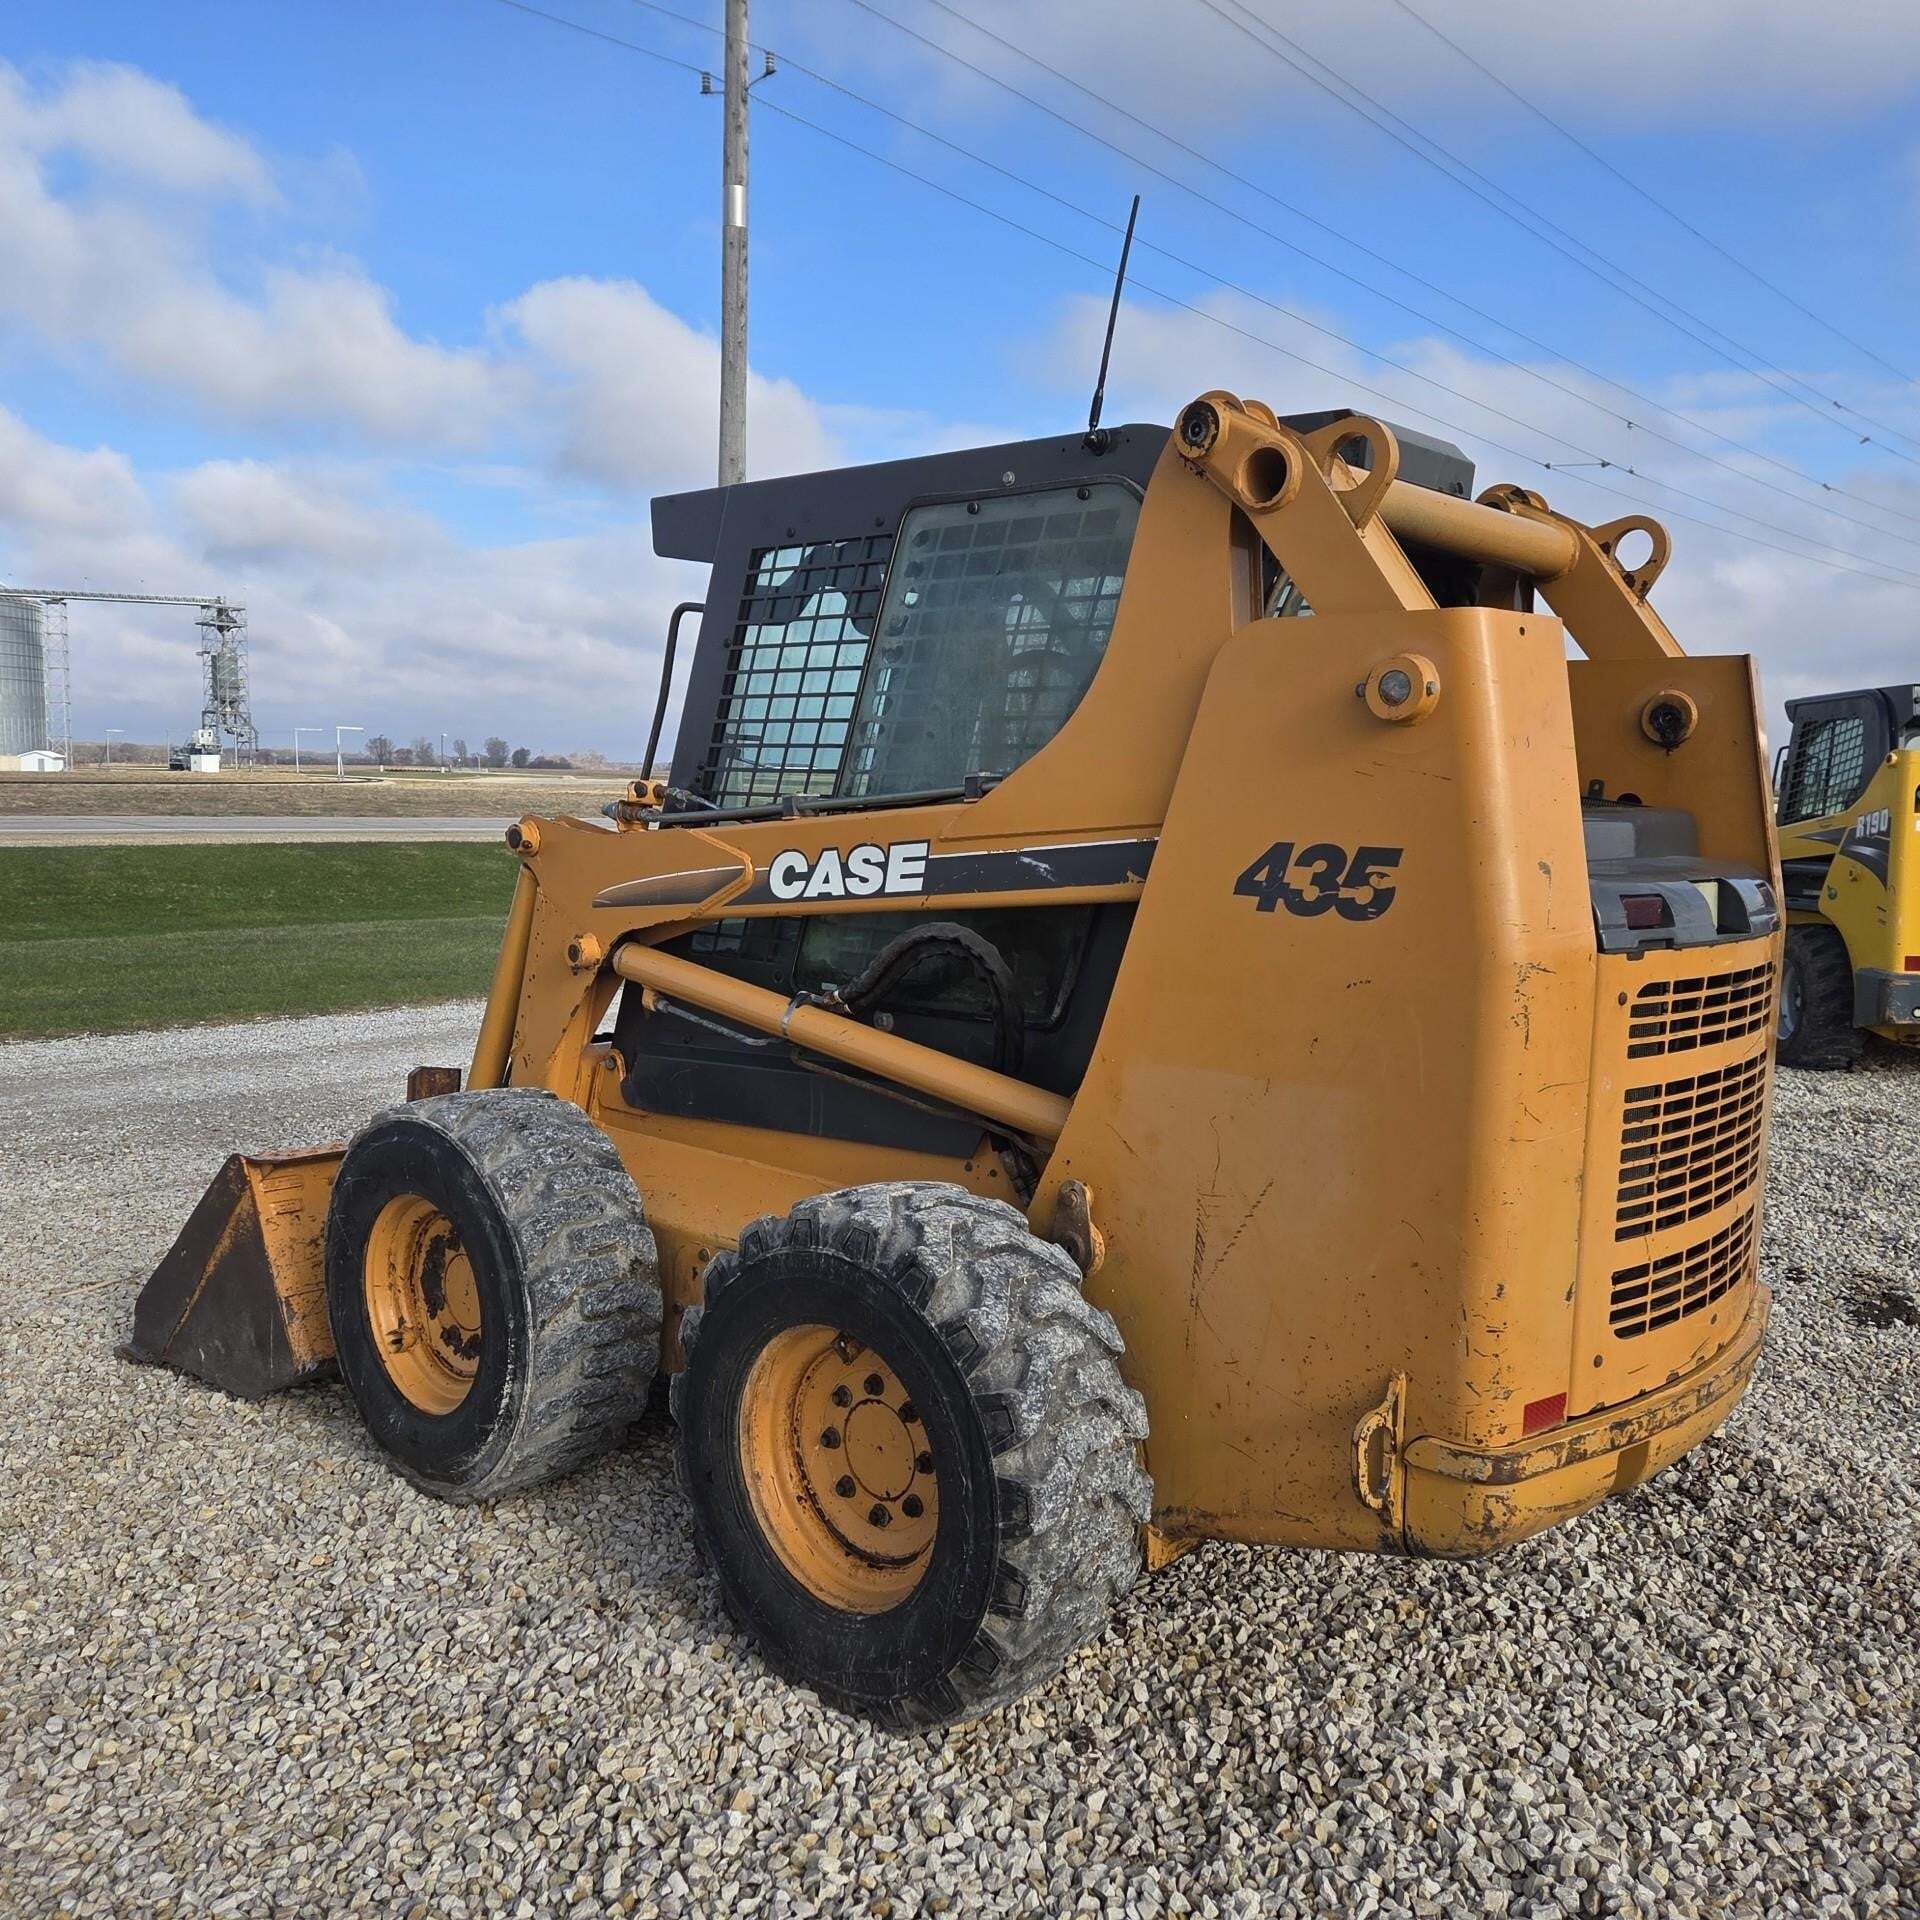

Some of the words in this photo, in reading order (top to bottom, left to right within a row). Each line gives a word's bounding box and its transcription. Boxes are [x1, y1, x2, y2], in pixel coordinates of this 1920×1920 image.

[1856, 808, 1889, 839] R190
[769, 842, 928, 899] CASE
[1233, 841, 1404, 920] 435
